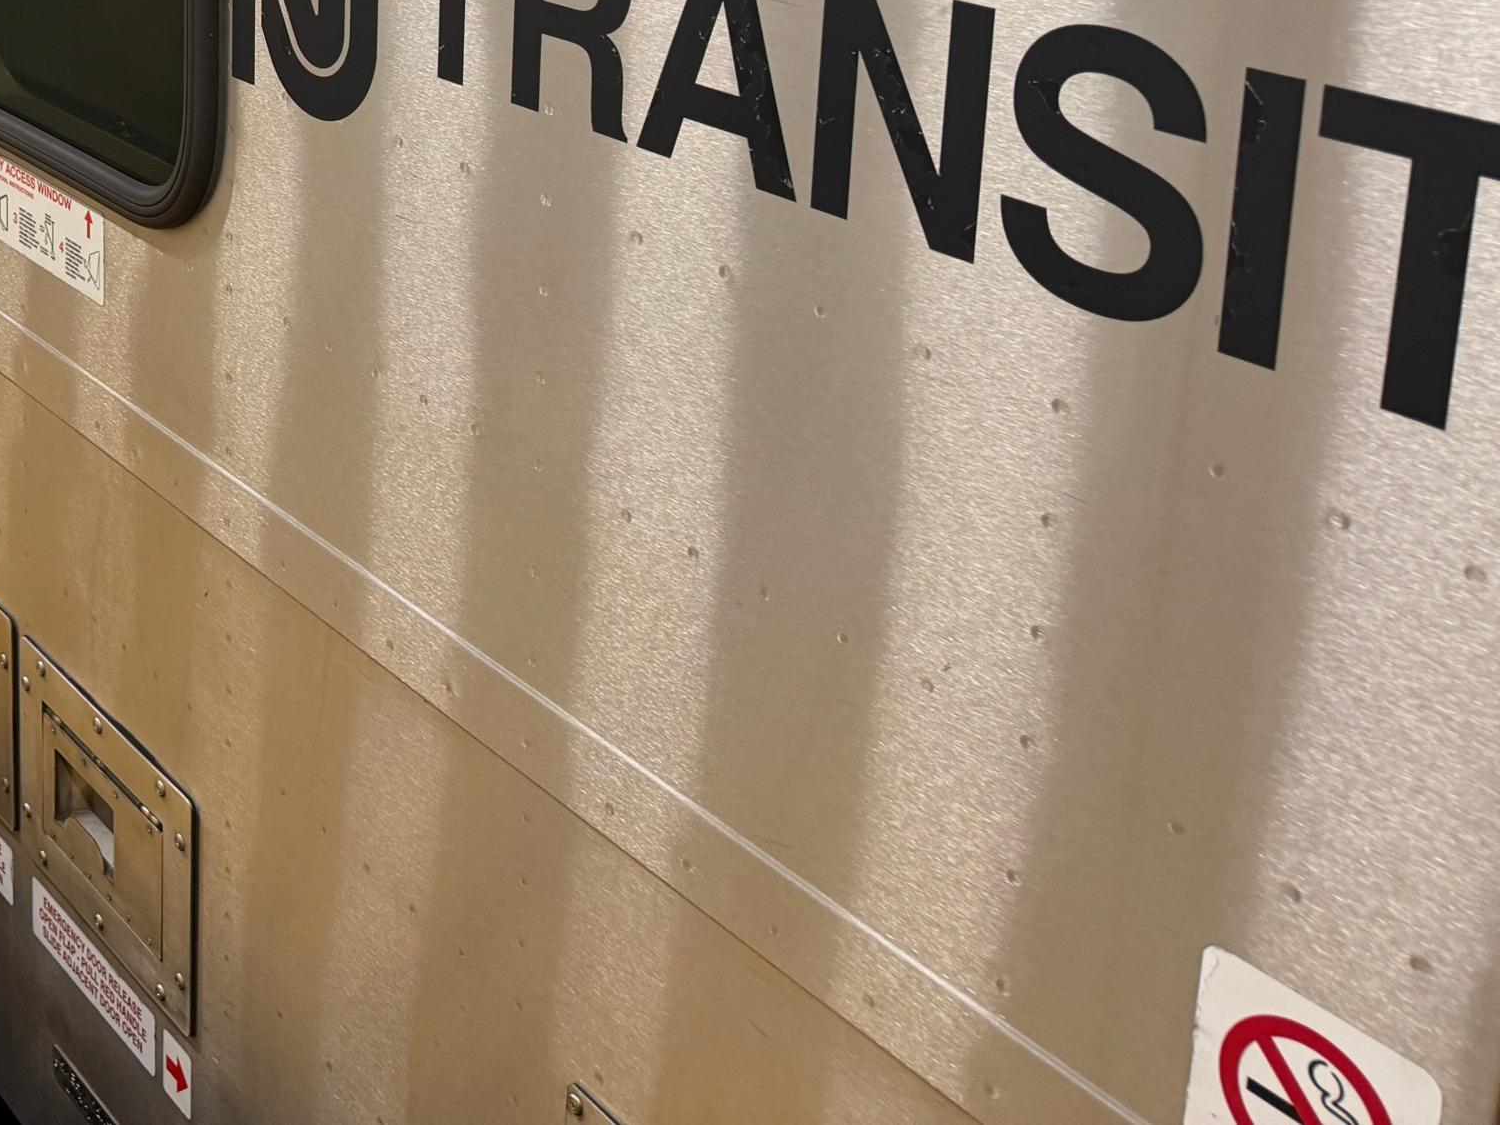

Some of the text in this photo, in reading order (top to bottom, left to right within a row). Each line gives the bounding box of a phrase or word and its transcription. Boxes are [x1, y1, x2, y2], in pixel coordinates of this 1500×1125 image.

[6, 164, 36, 190] ACCESS
[37, 181, 72, 211] WINDOW
[13, 212, 18, 224] 3
[59, 242, 64, 253] 4
[39, 907, 57, 936] OPEN
[59, 929, 76, 955] FLAP
[81, 956, 99, 986] PULL
[100, 979, 115, 1004] RED
[116, 997, 147, 1043] HANDLE
[42, 925, 143, 1053] SLIDE ADJACENT DOOR OPEN
[43, 896, 142, 1021] EMERGENCY DOOR RELEASE
